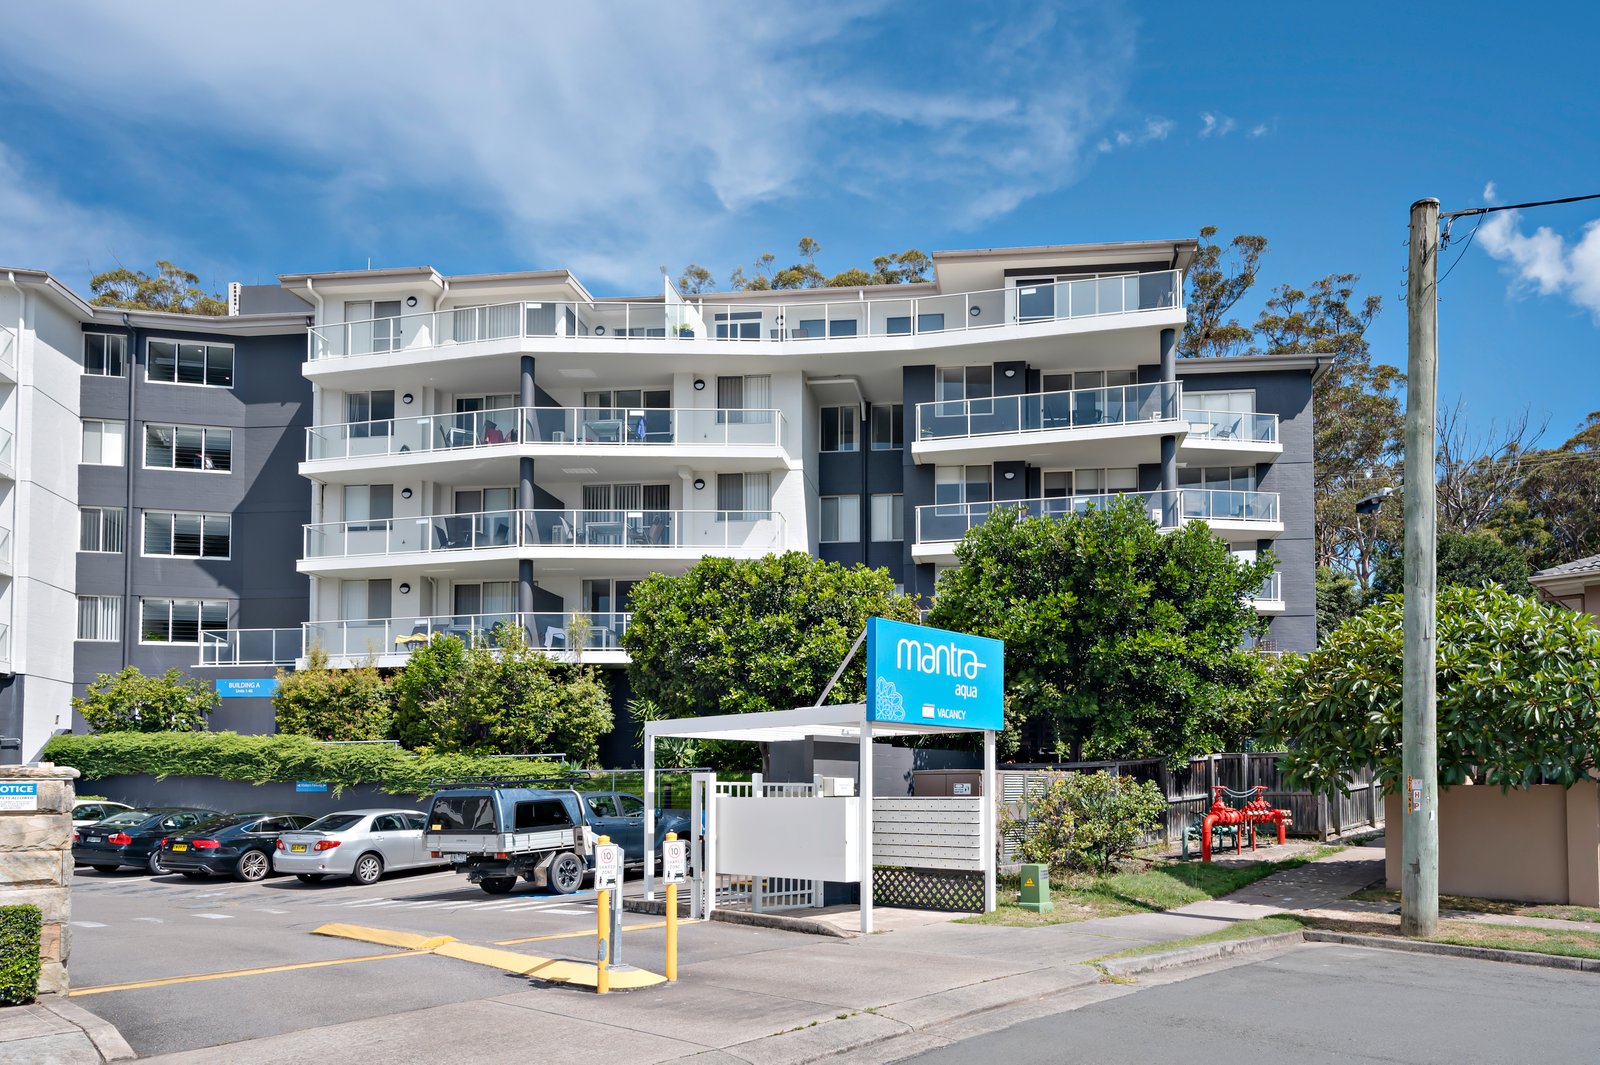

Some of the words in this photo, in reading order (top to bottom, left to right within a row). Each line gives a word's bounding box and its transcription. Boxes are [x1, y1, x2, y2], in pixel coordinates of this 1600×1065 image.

[897, 638, 987, 680] mantra
[955, 684, 978, 700] aqua
[937, 708, 967, 720] VACANCY
[0, 785, 34, 793] OTICE
[603, 851, 612, 860] 10
[670, 847, 679, 856] 10
